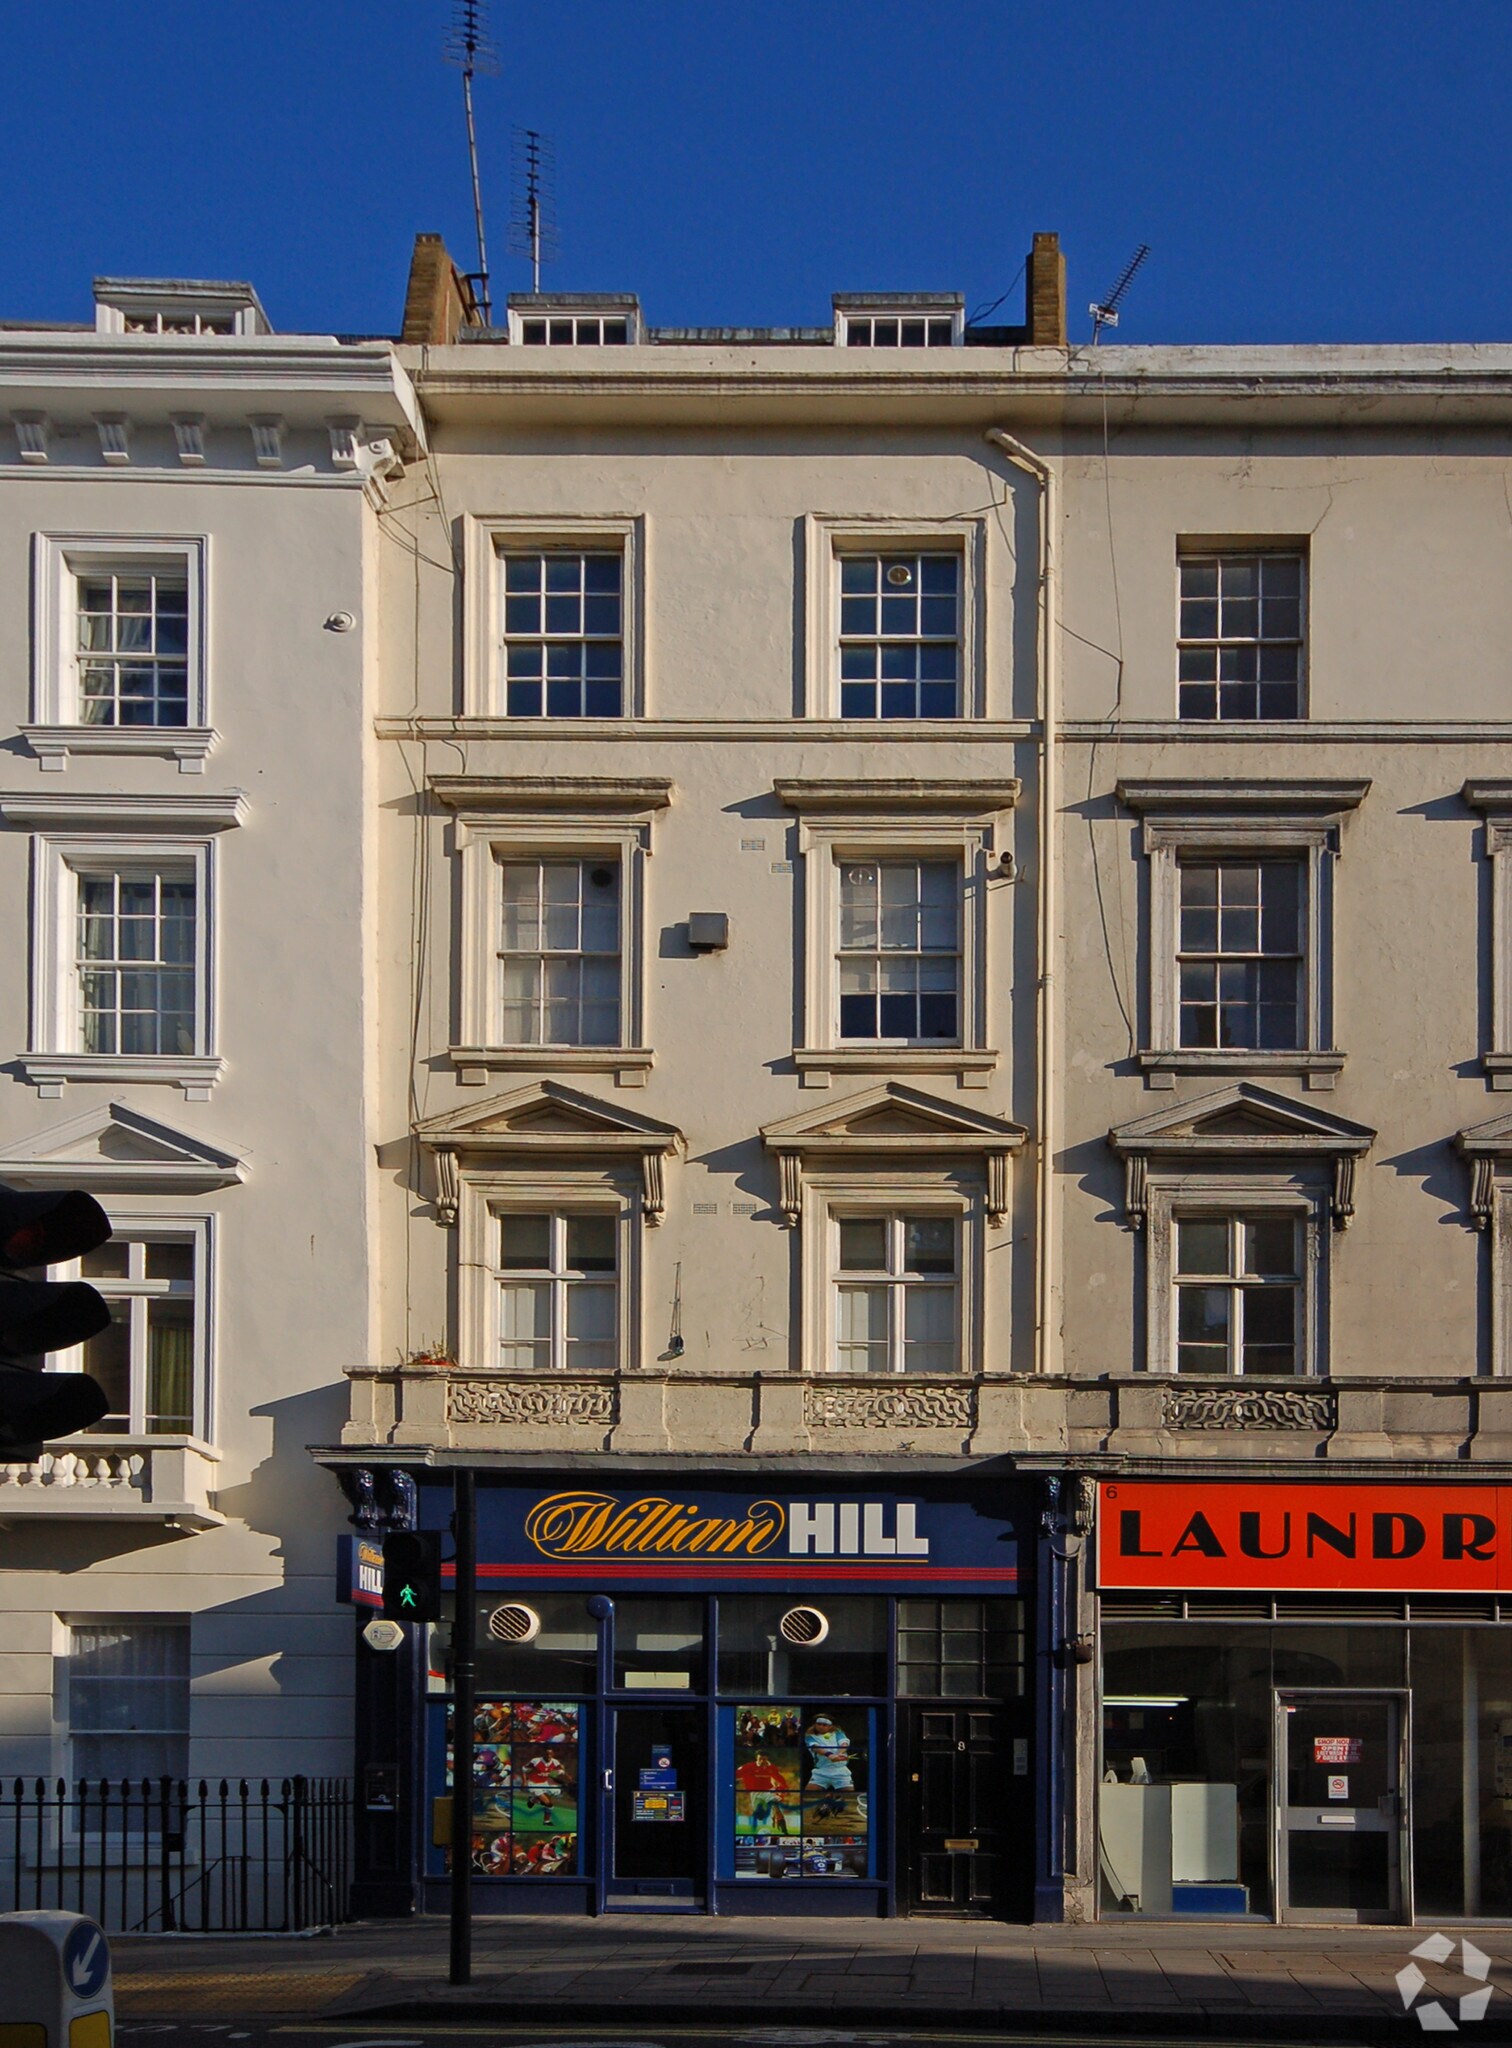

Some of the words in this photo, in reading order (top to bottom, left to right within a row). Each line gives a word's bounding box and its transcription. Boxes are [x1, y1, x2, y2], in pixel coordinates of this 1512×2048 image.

[1105, 1485, 1118, 1499] 6
[525, 1491, 785, 1556] William
[789, 1502, 929, 1554] HILL
[1119, 1509, 1512, 1561] LAUNDR
[359, 1565, 384, 1595] HILL
[957, 1741, 966, 1751] 8
